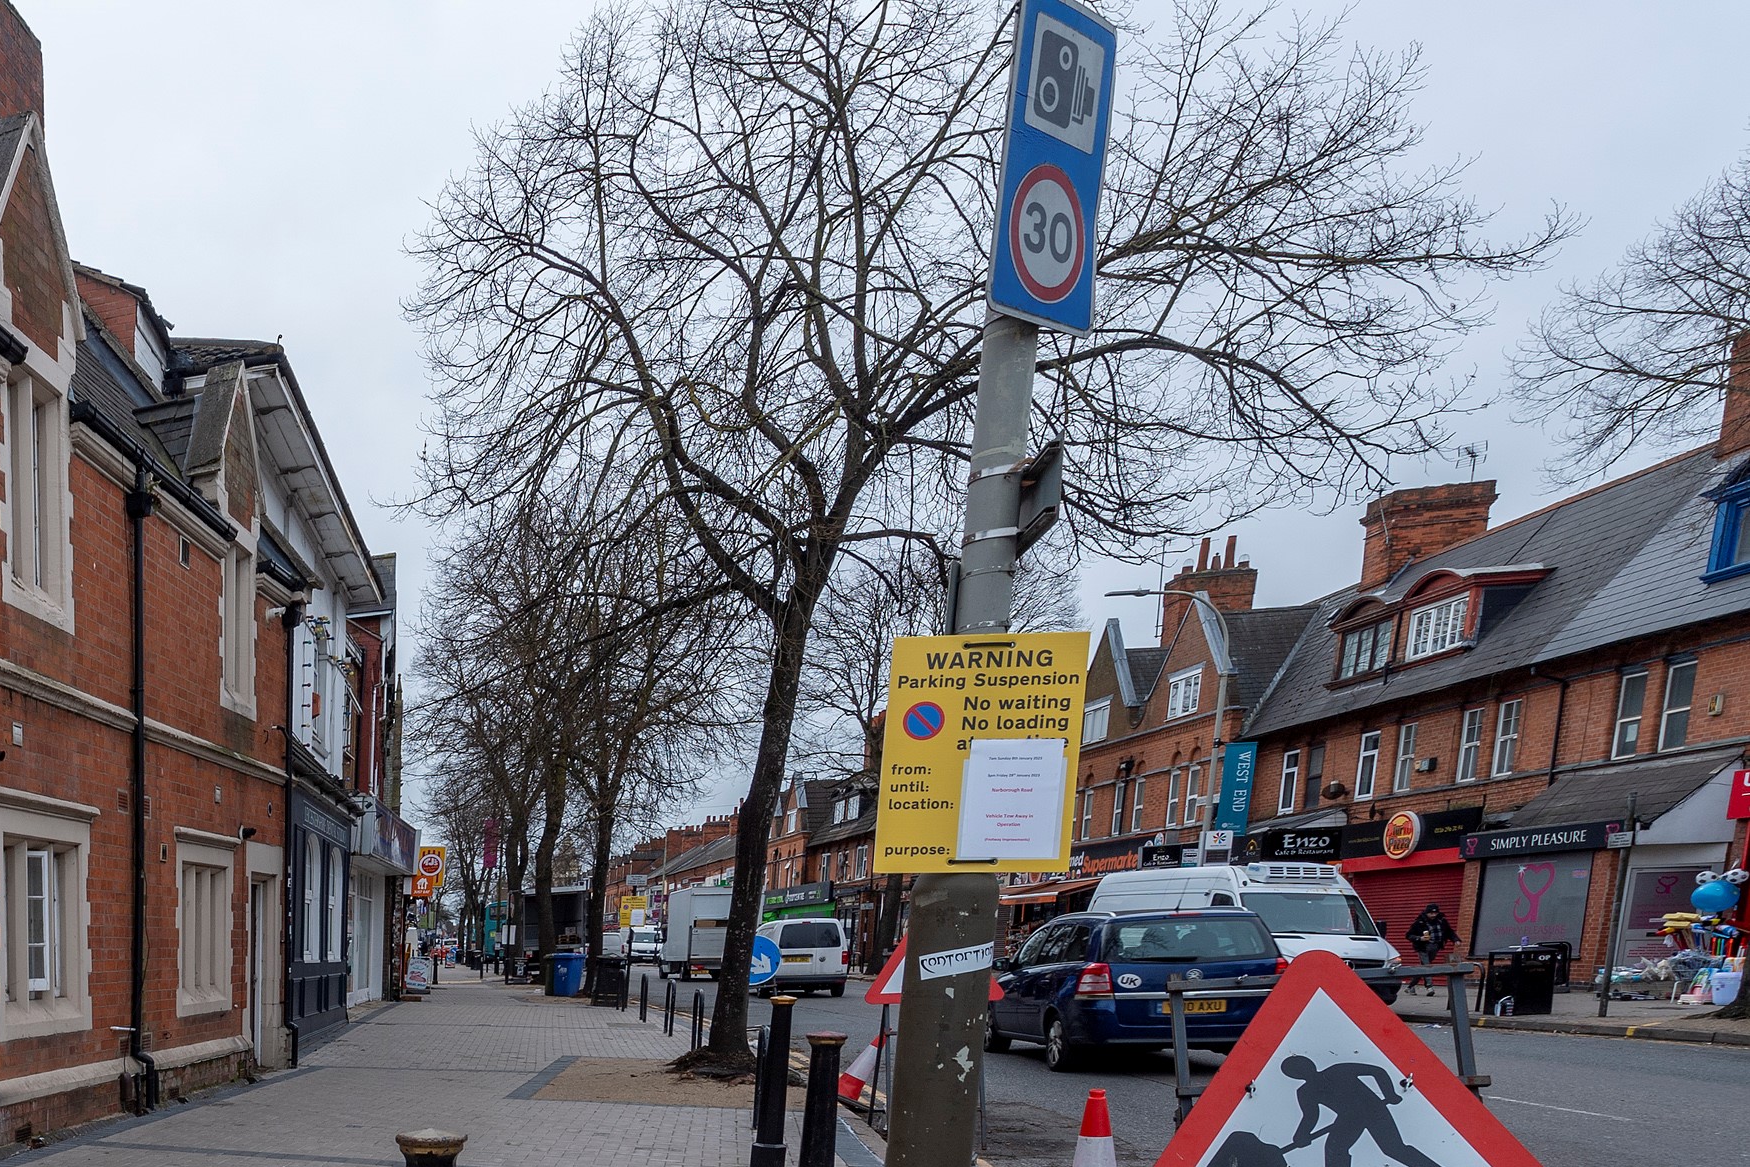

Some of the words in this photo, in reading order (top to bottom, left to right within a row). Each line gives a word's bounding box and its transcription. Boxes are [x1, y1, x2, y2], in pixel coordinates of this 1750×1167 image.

[1023, 201, 1073, 264] 30
[926, 649, 1053, 670] WARNING
[898, 675, 966, 690] Parking
[973, 671, 1080, 689] Suspension
[963, 696, 991, 711] No
[998, 694, 1071, 711] waiting
[961, 716, 989, 731] No
[997, 714, 1069, 731] loading
[891, 763, 932, 775] from:
[1236, 751, 1252, 783] WEST
[890, 781, 929, 793] until:
[888, 798, 954, 810] location:
[1232, 789, 1248, 812] END
[1282, 833, 1330, 849] Enzo
[1490, 835, 1529, 851] SIMPLY
[1531, 829, 1587, 847] PLEASURE
[884, 843, 951, 858] purpose:
[1274, 848, 1289, 856] Cafe
[1082, 850, 1139, 877] Supermarke
[1121, 976, 1139, 987] UK
[1198, 1001, 1222, 1011] AXU
